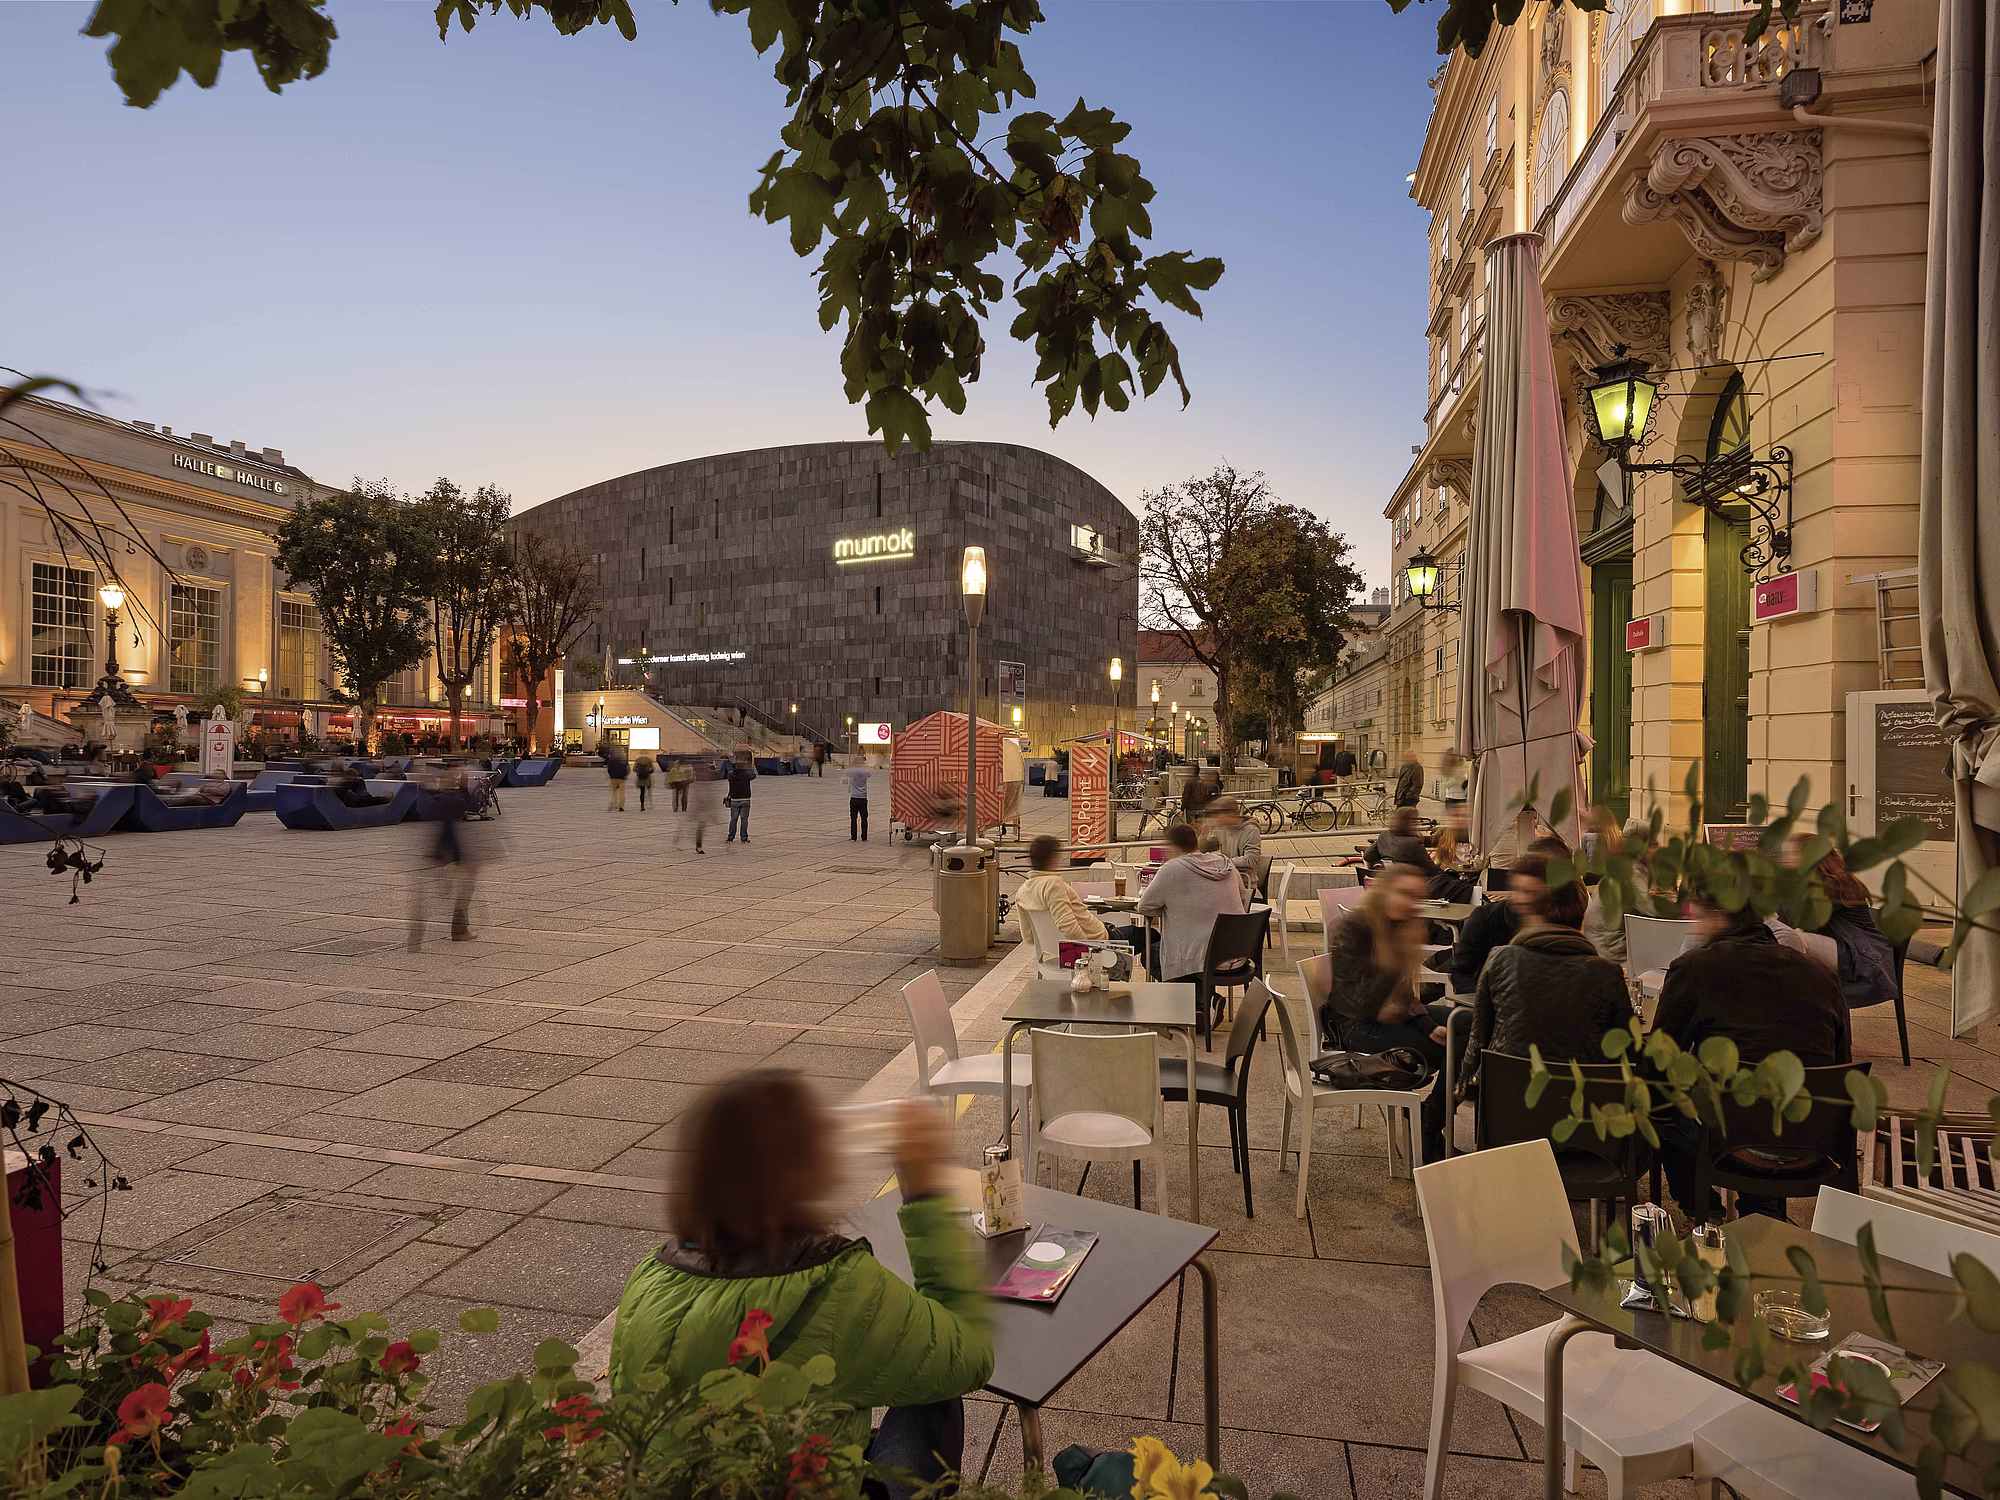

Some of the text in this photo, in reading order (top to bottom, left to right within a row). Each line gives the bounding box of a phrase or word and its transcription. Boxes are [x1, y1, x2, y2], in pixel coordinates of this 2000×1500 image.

[173, 453, 283, 493] HALLE E HALLE G
[834, 527, 914, 558] mumok
[1766, 591, 1784, 606] daily
[602, 716, 648, 725] Kunsthalle Wien
[1077, 779, 1092, 820] Point
[1093, 796, 1101, 812] Shop
